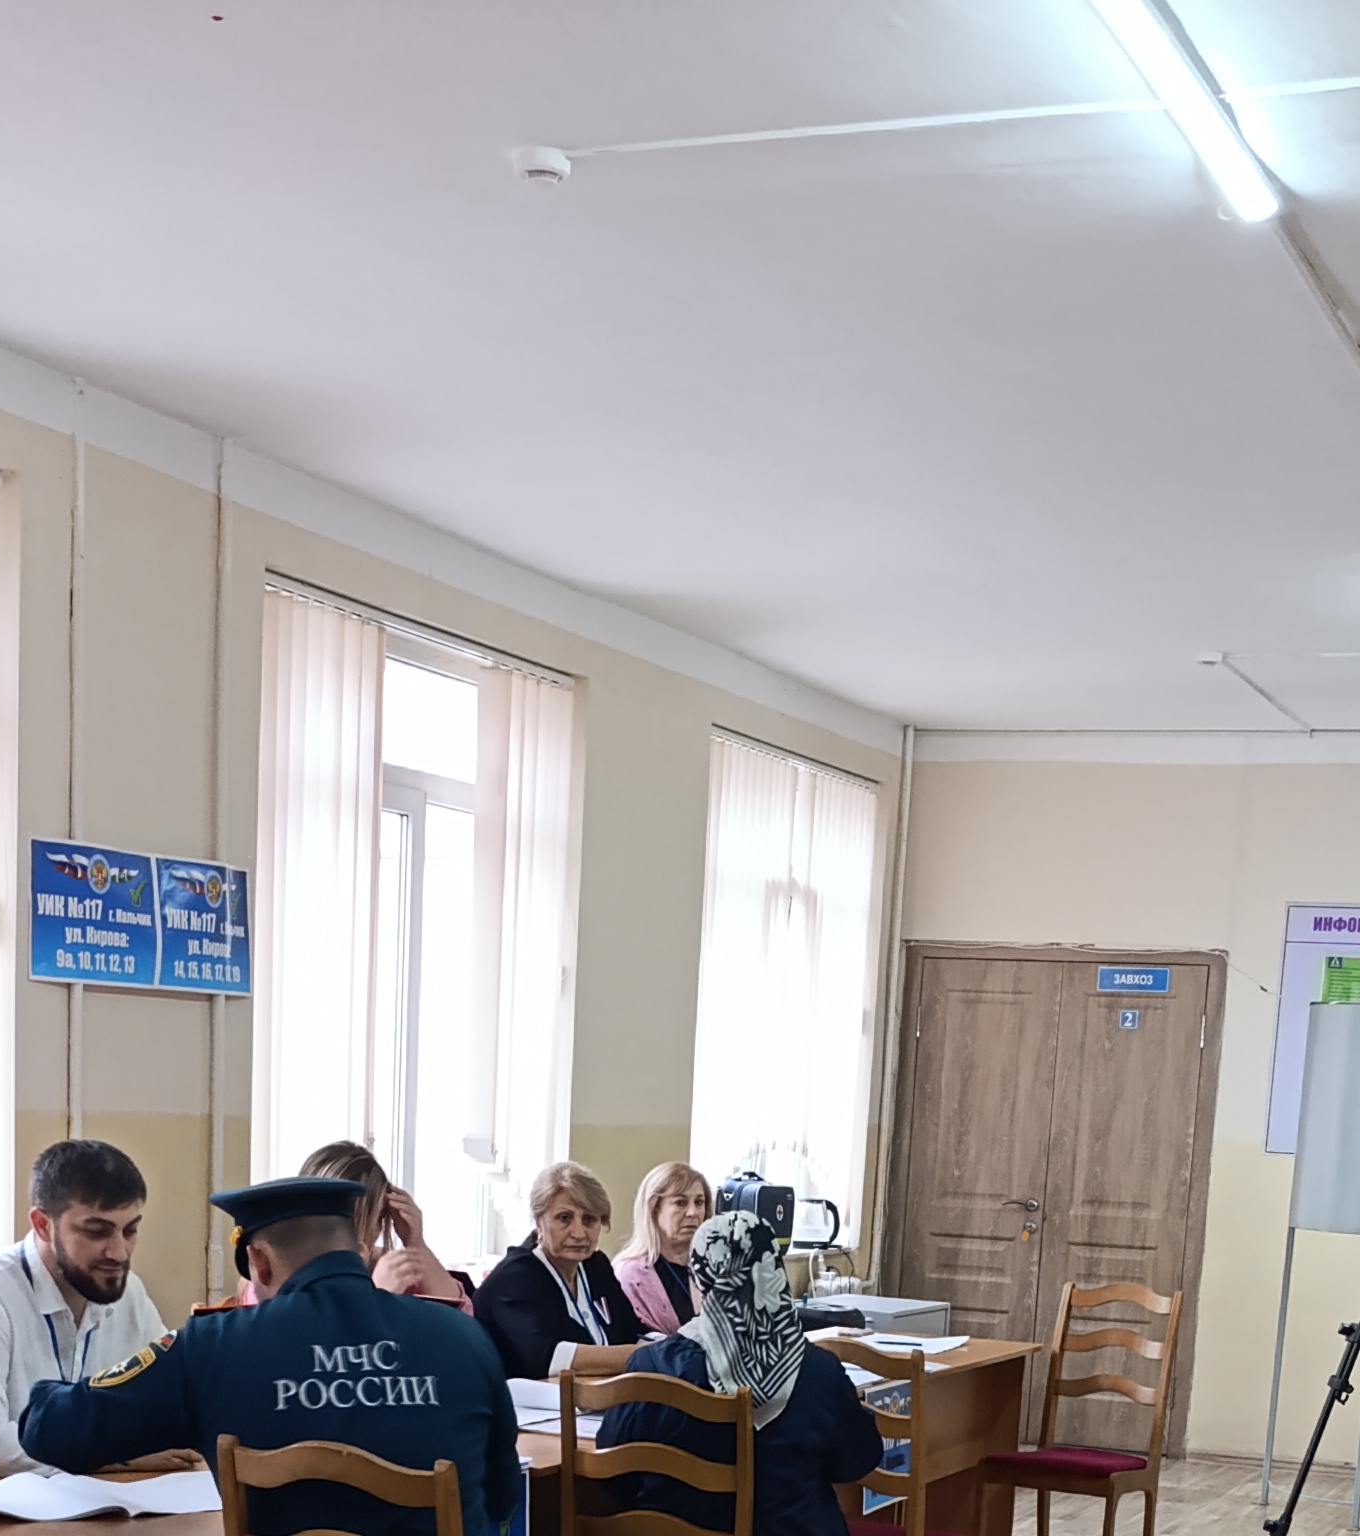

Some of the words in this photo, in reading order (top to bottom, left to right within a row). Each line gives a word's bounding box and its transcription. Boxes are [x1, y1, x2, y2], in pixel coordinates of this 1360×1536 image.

[37, 893, 64, 917] УИК
[68, 896, 103, 920] №117
[116, 908, 152, 926] Нальчик
[166, 907, 188, 930] УИК
[190, 910, 216, 933] №117
[65, 926, 84, 944] ул.
[86, 926, 129, 947] Кирова:
[188, 939, 201, 955] ул.
[56, 949, 76, 970] 9а,
[78, 951, 93, 972] 10,
[123, 955, 135, 974] 13
[1114, 974, 1153, 985] ЗАВХОЗ
[1124, 1013, 1132, 1026] 2
[311, 1340, 401, 1373] МЧС
[272, 1375, 440, 1411] РОССИИ
